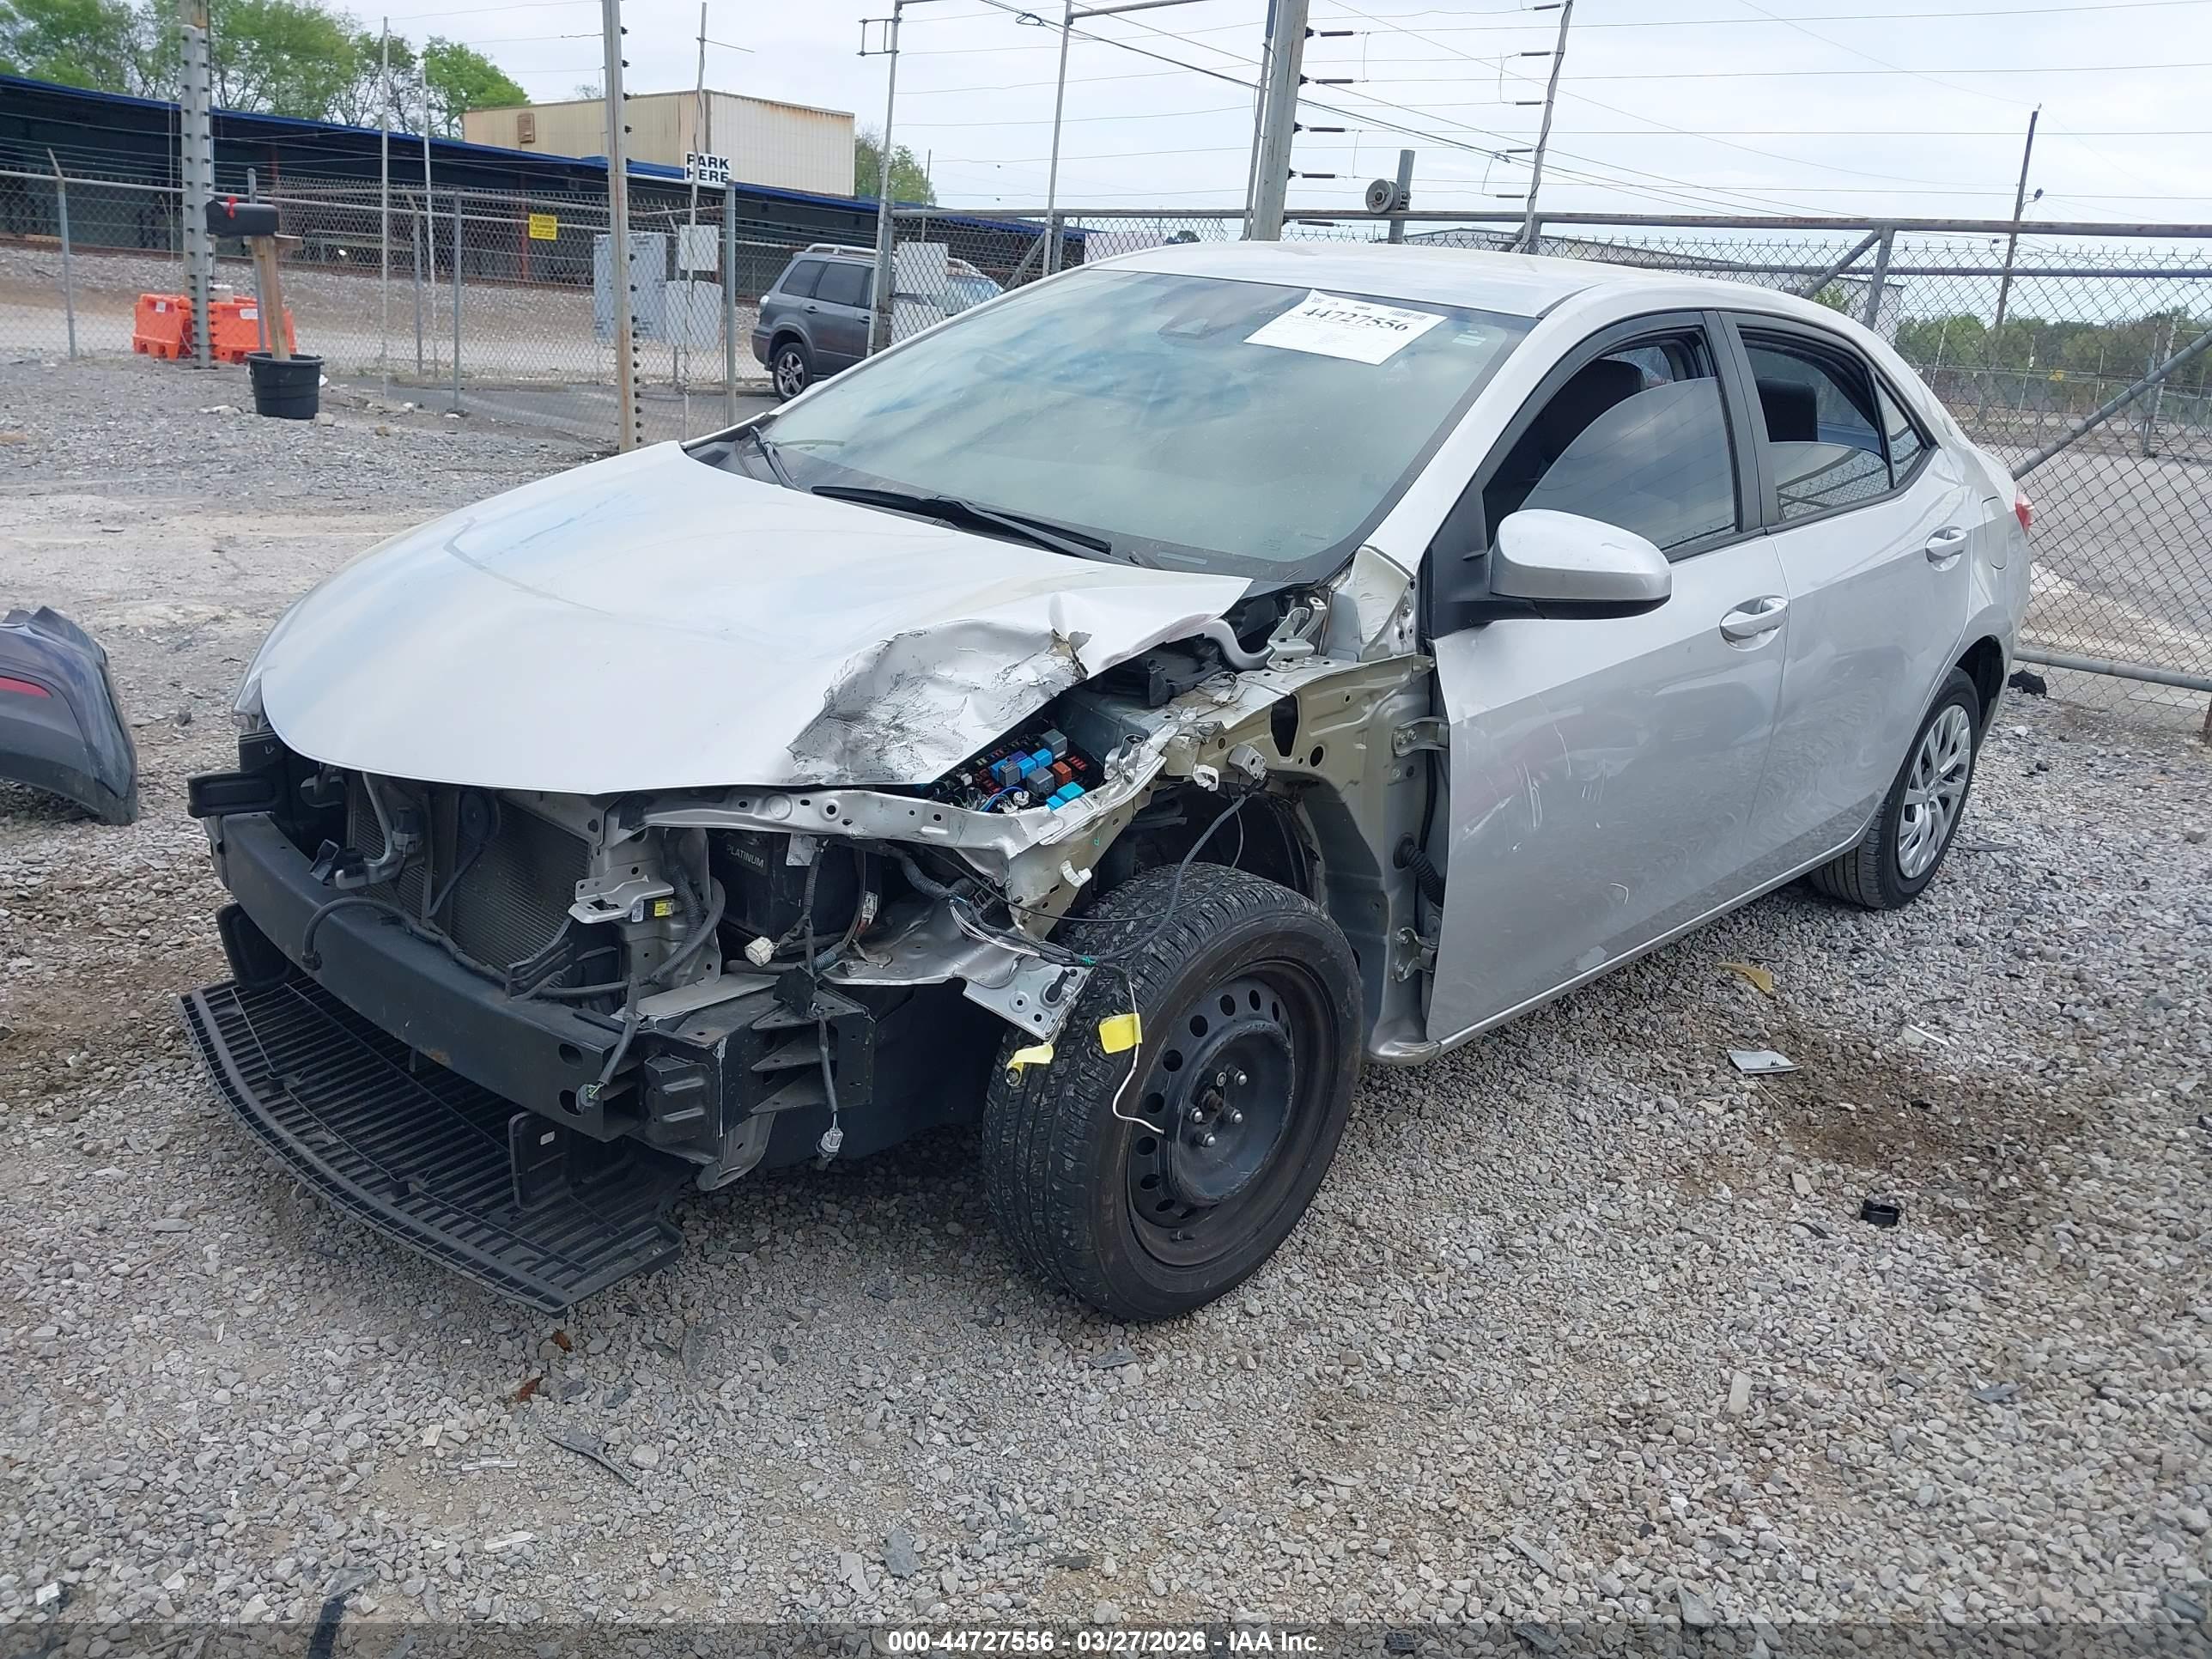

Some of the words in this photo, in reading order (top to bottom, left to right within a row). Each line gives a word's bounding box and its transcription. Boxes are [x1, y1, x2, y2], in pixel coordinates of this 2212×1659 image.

[686, 154, 730, 170] PARK
[686, 167, 729, 184] HERE
[1302, 307, 1415, 331] 44727556
[726, 844, 764, 868] PLATINUM
